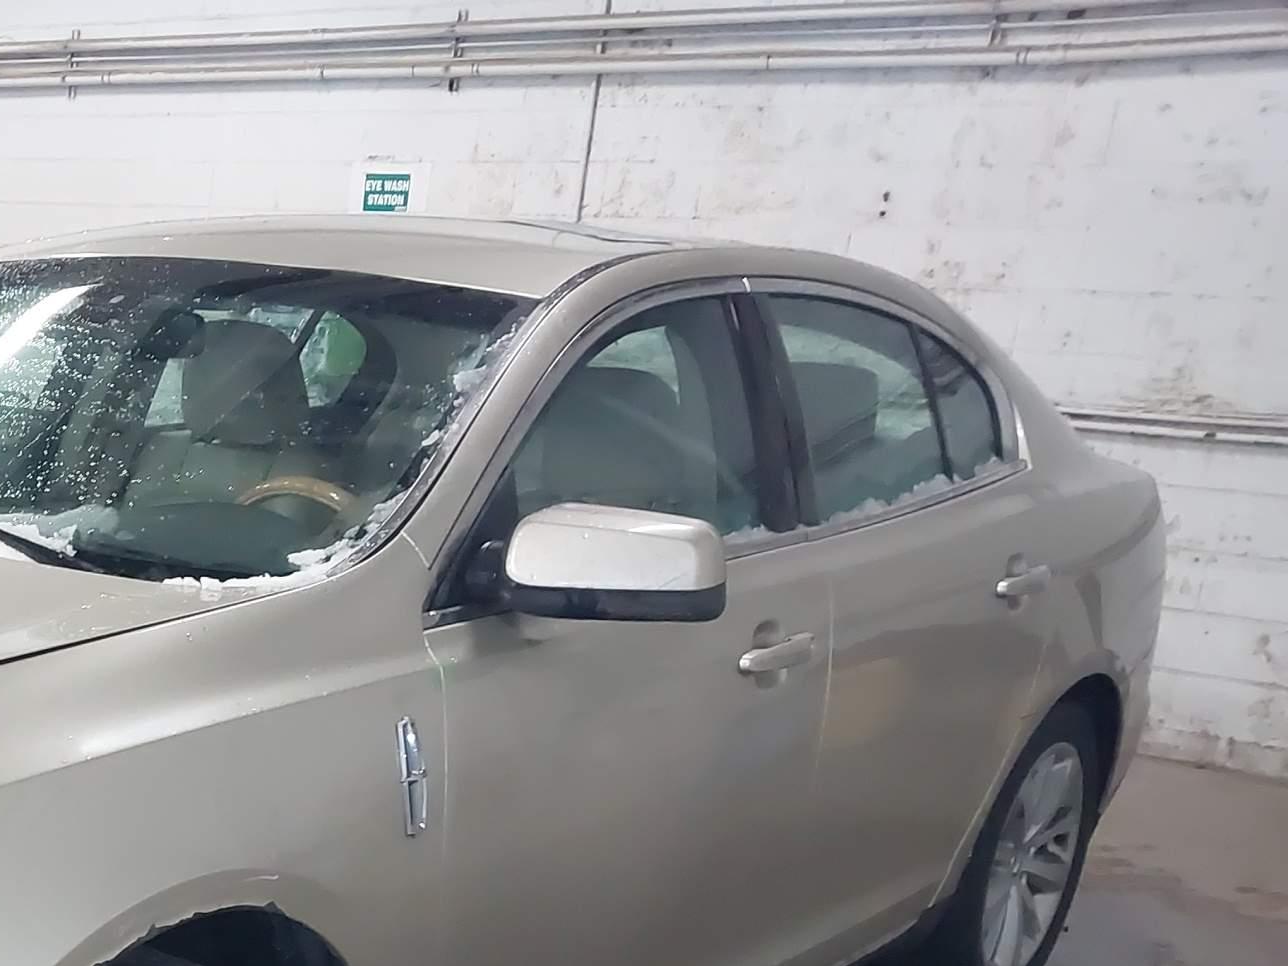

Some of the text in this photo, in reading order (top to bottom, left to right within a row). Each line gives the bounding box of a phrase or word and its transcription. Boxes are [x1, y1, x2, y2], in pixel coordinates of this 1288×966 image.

[366, 179, 409, 191] EYE WASH
[367, 194, 405, 206] STATION
